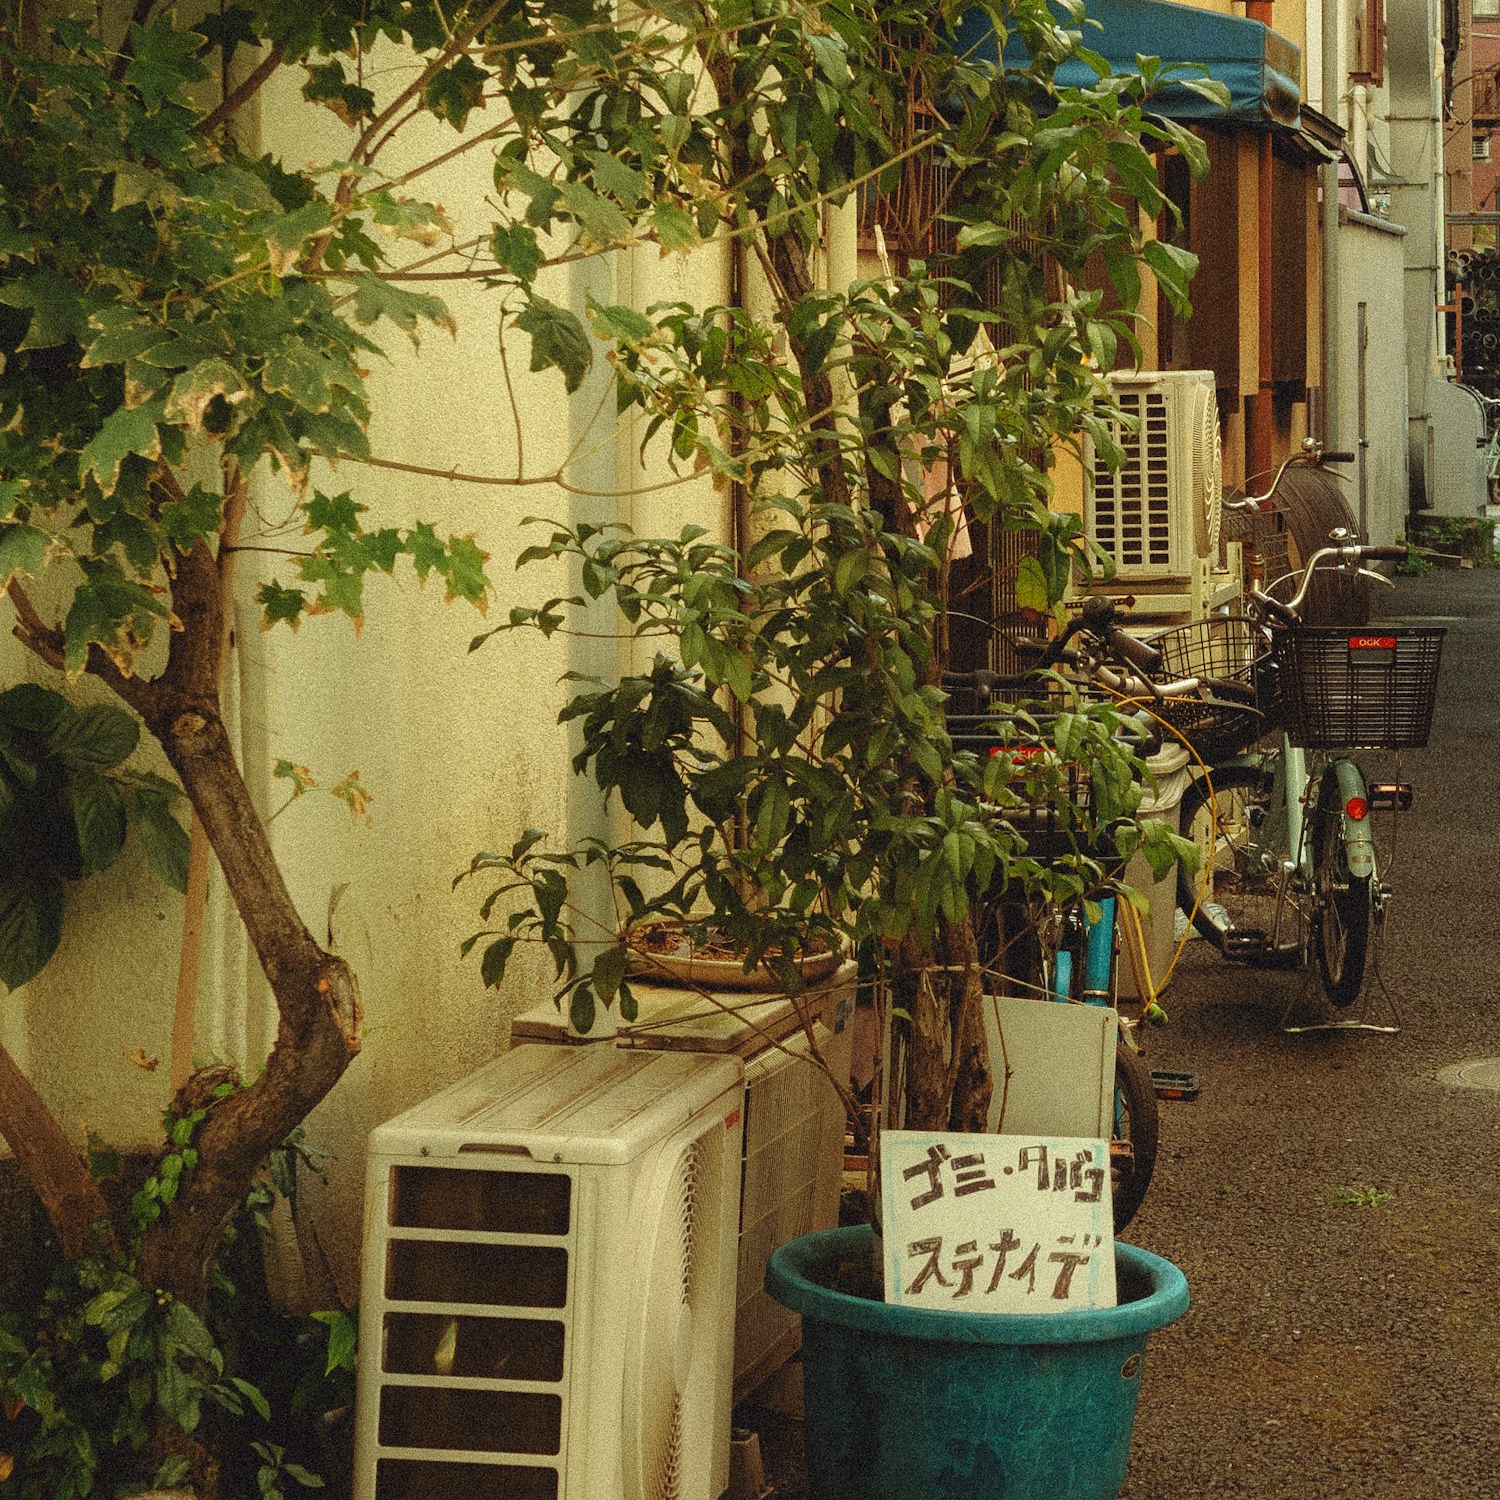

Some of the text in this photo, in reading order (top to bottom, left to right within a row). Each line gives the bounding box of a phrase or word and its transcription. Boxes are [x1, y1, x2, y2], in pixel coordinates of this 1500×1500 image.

[1358, 638, 1380, 646] OGK
[904, 1228, 1102, 1300] ステナイデ
